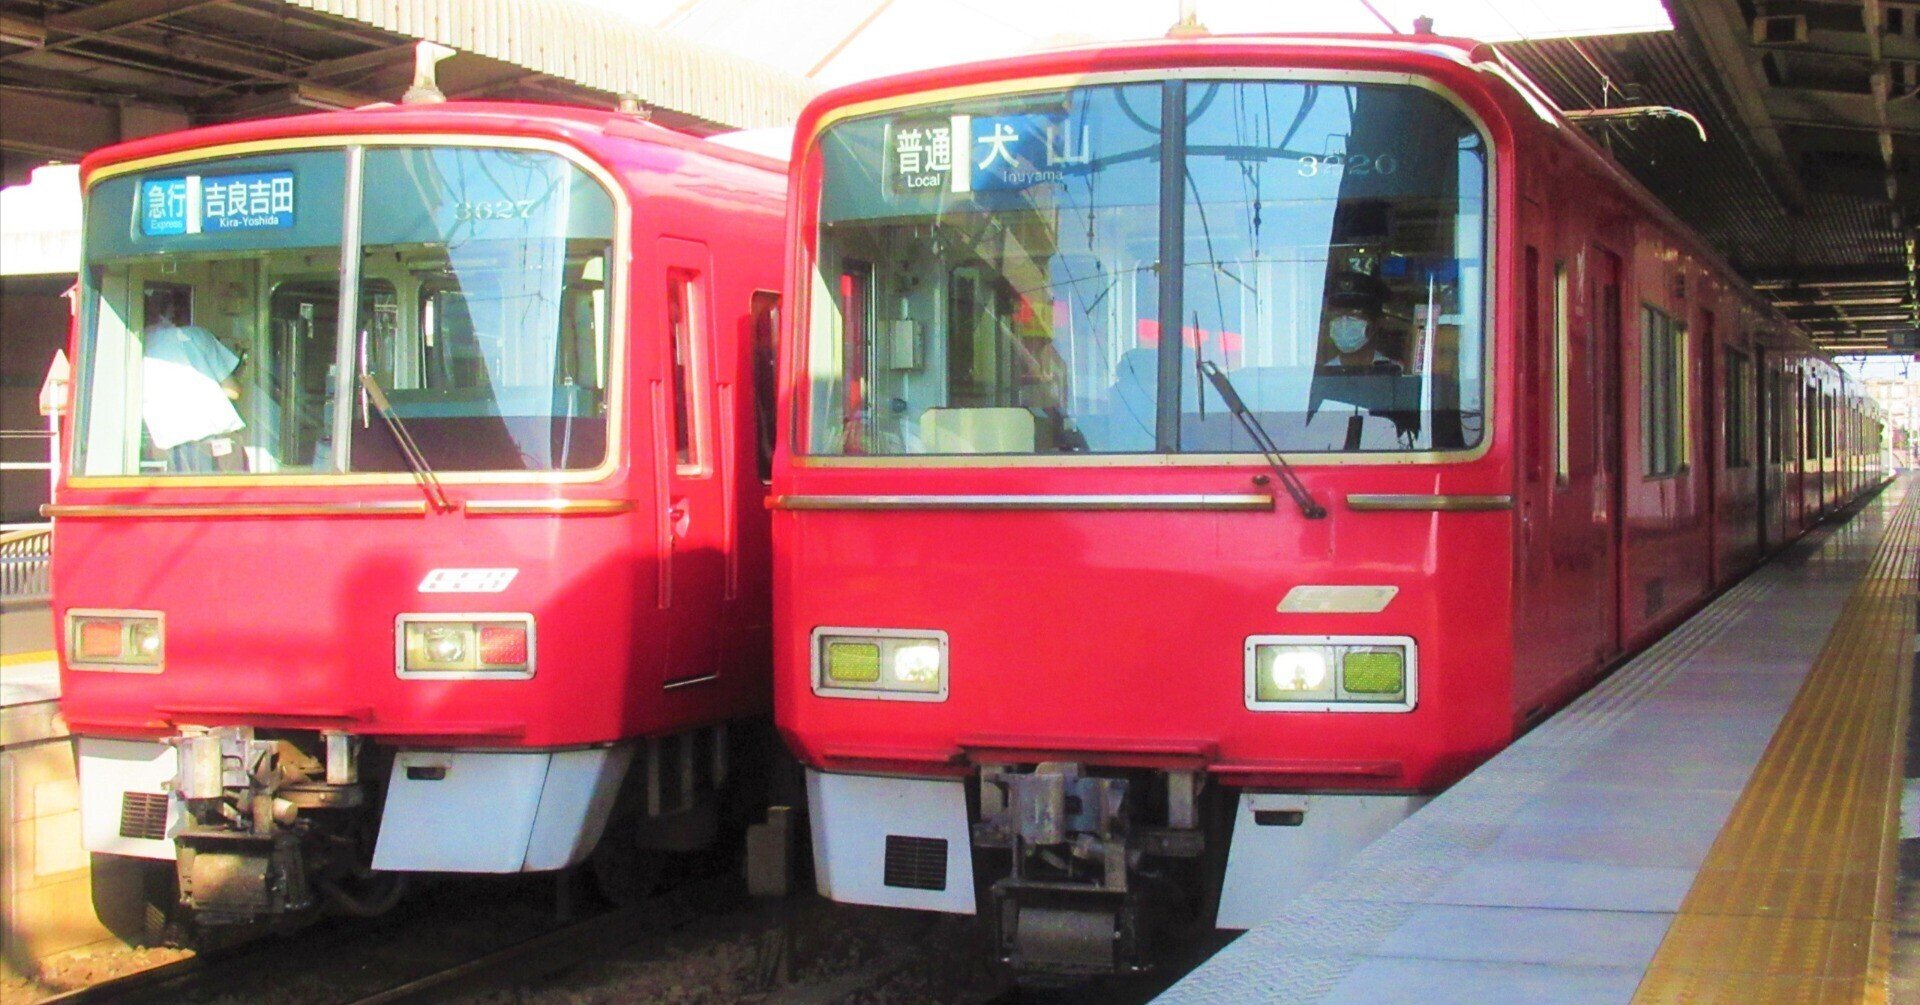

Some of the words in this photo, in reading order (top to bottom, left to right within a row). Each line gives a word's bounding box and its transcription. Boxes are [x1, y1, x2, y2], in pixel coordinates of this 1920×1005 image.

[897, 128, 951, 174] 普通
[978, 119, 1089, 170] 犬山
[907, 173, 940, 188] Local
[1004, 169, 1063, 185] Inuyama
[149, 184, 186, 218] 急行
[205, 177, 293, 218] 吉良吉田
[151, 220, 183, 229] Express
[220, 216, 279, 227] Kira-Yoshida
